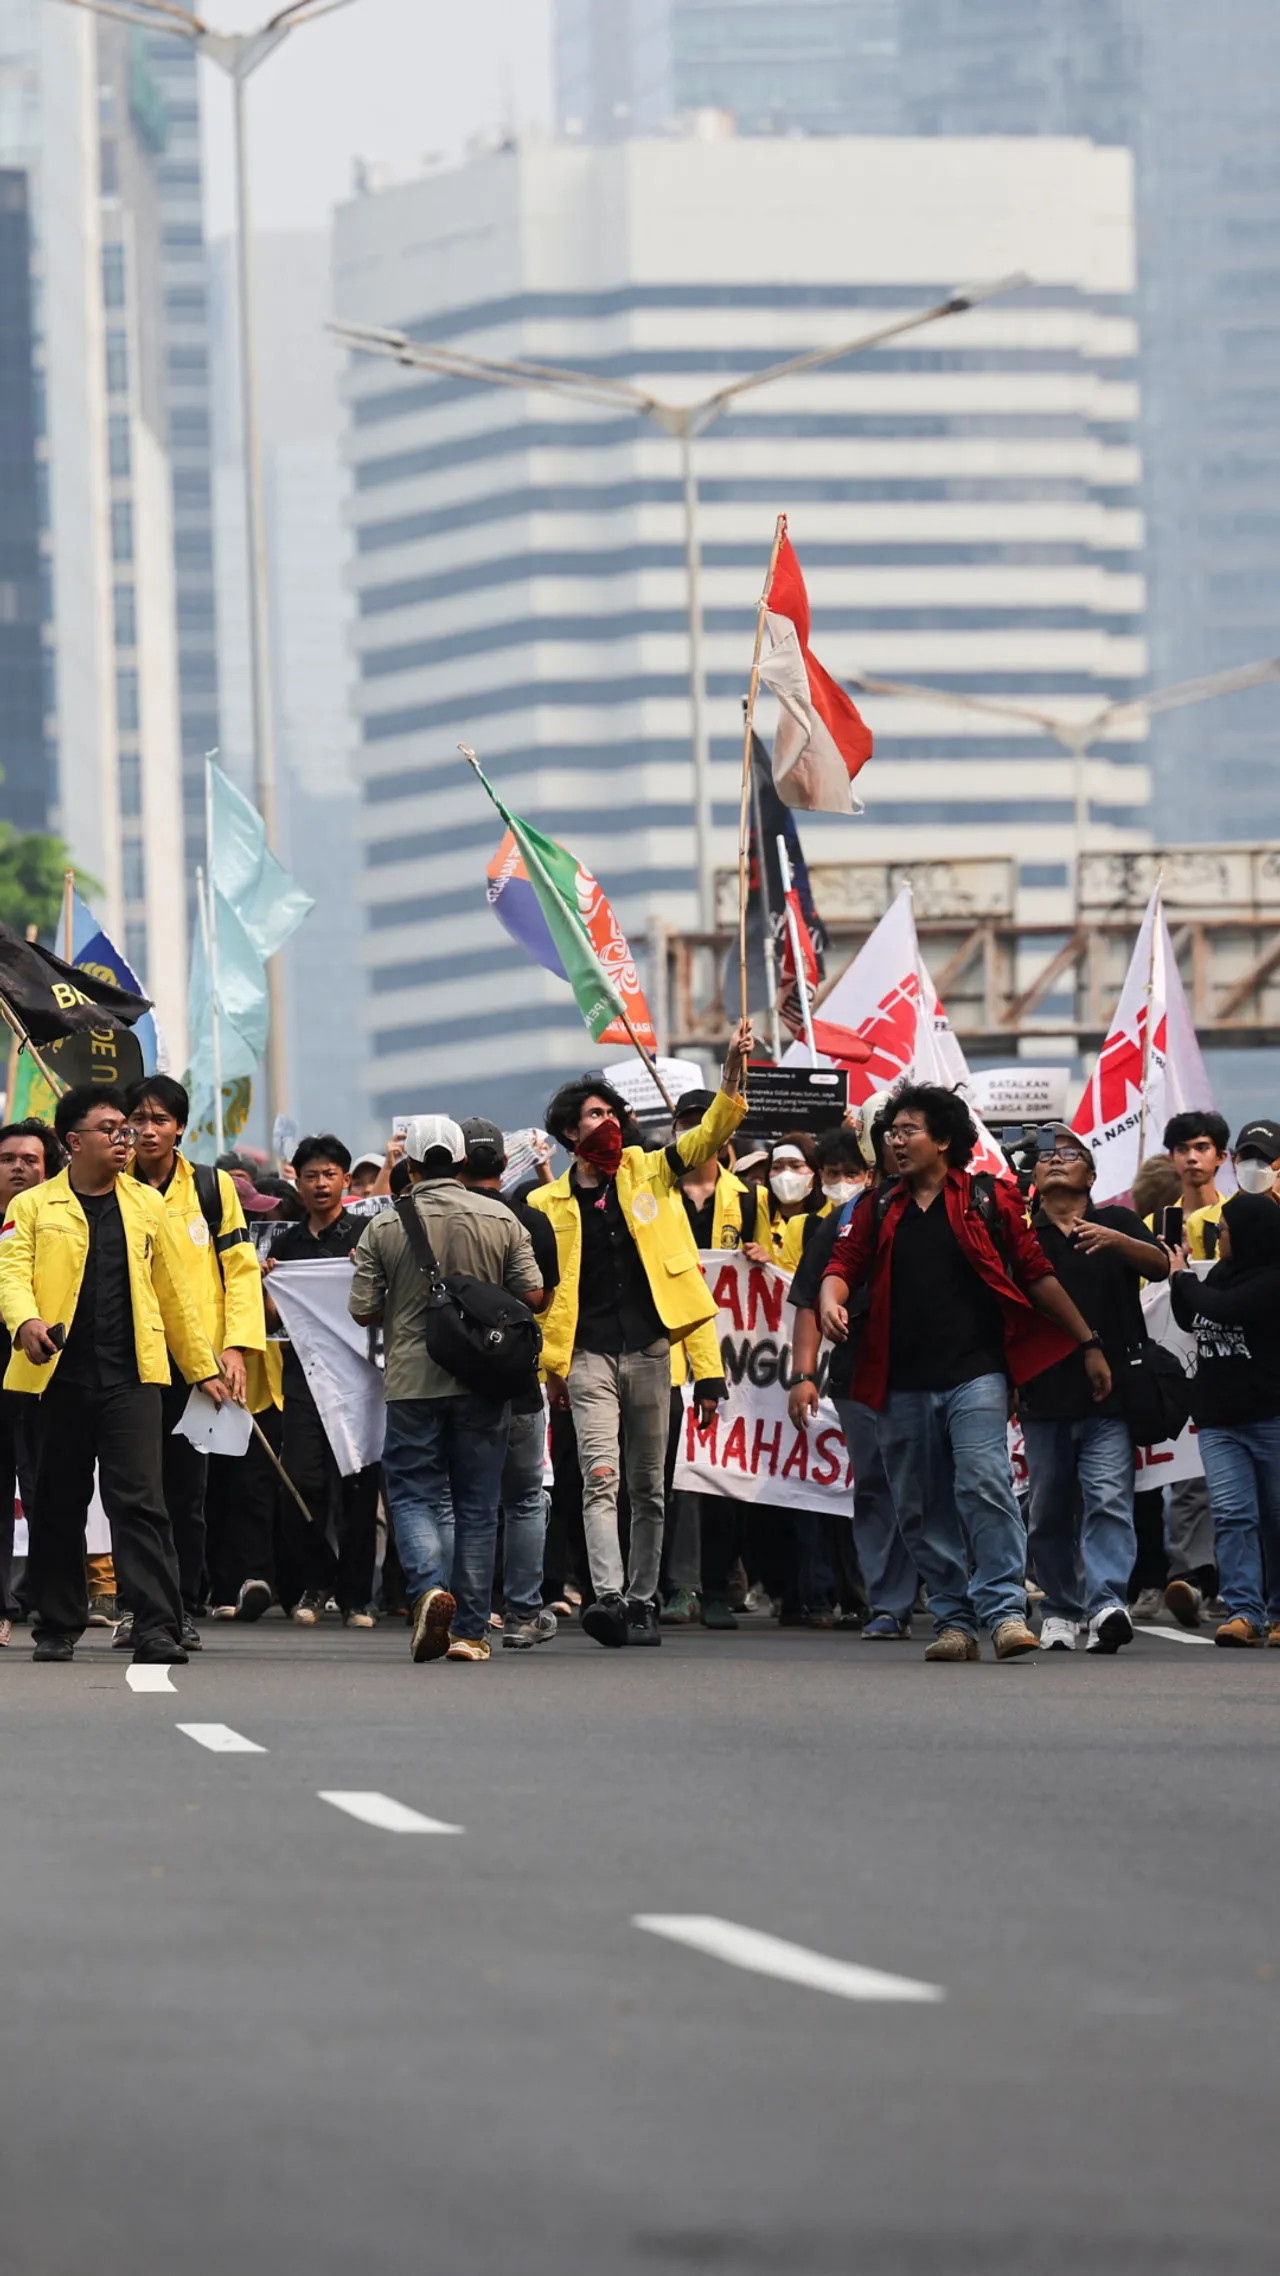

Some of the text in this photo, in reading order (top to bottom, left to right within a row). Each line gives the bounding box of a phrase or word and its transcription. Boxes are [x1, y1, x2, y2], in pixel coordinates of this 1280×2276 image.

[989, 1080, 1049, 1089] BATALKAN
[989, 1092, 1049, 1100] KENAIKAN
[984, 1103, 1022, 1112] HARGA
